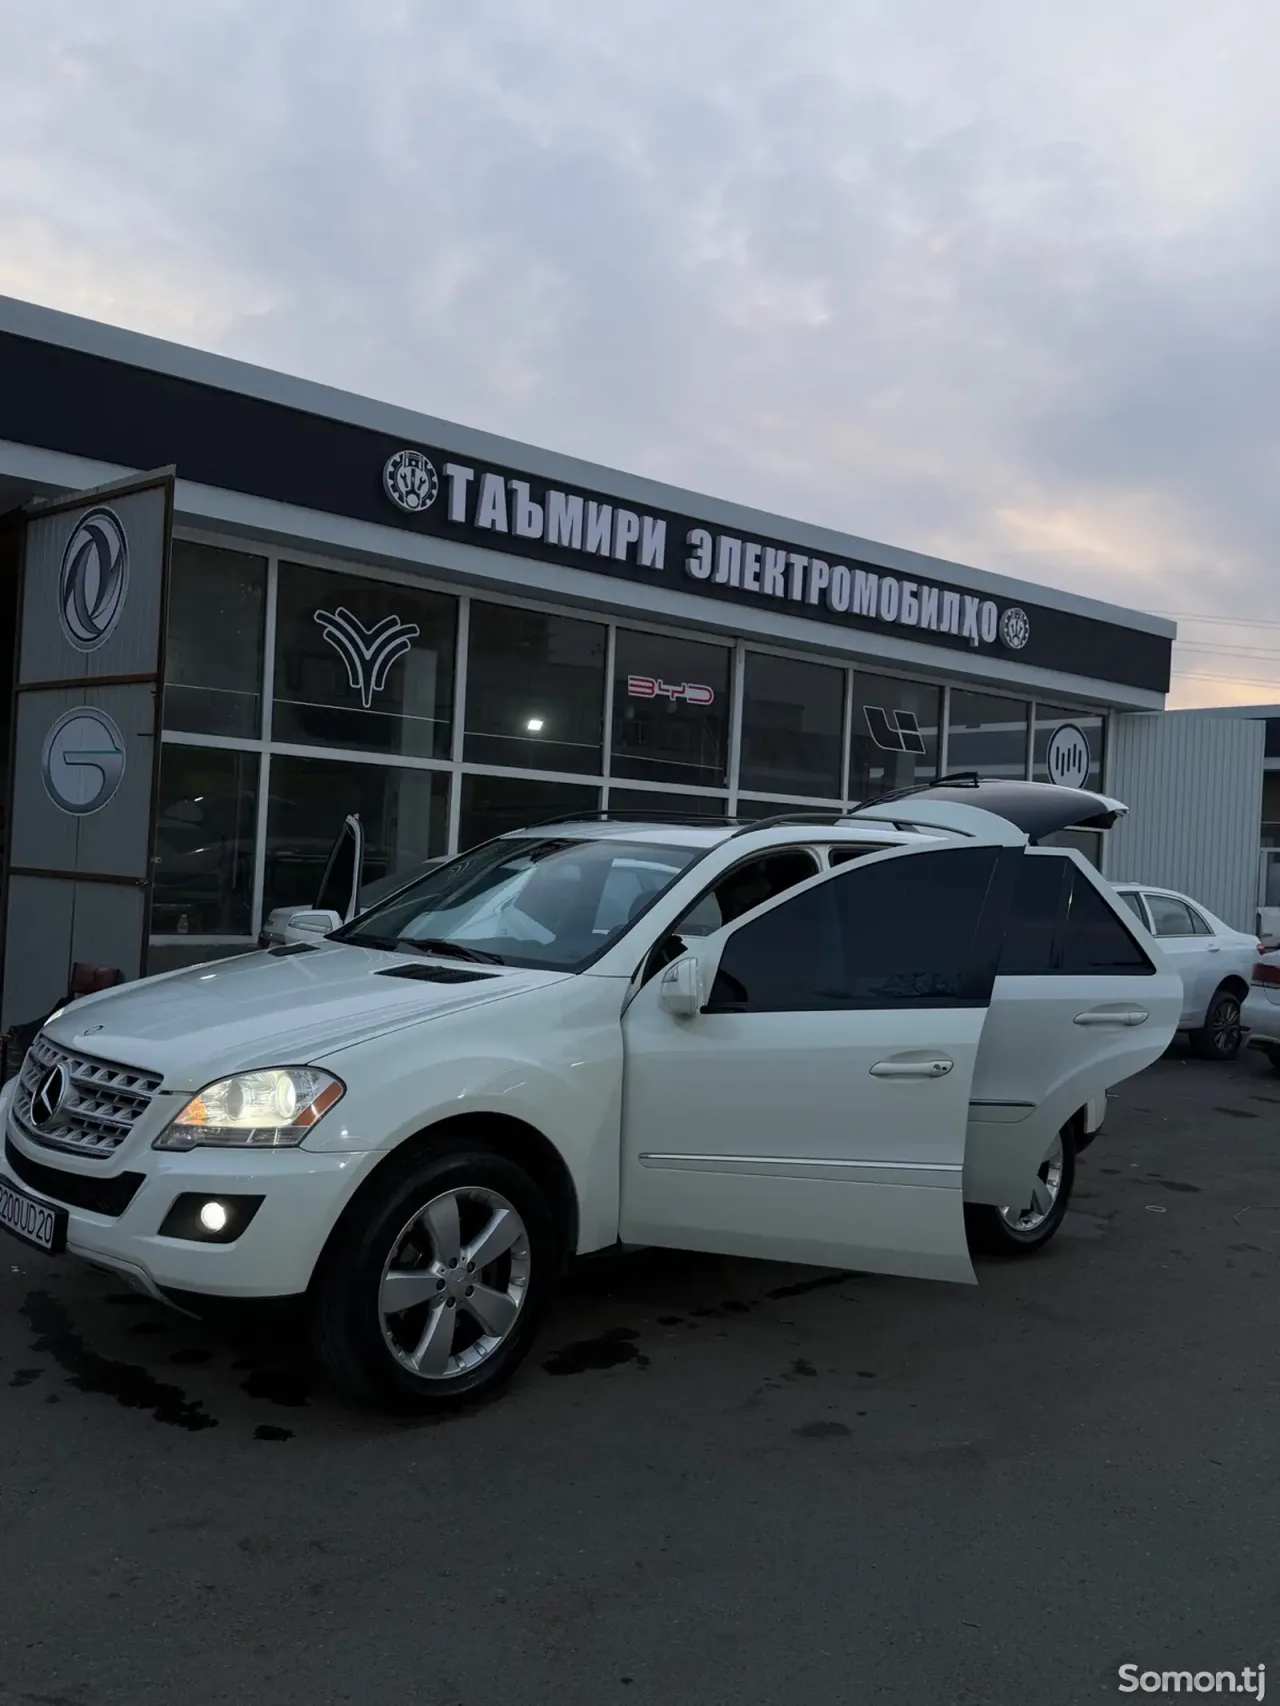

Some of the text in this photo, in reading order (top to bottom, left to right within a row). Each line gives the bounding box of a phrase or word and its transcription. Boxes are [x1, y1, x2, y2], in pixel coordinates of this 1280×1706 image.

[442, 462, 998, 647] ТАЪМИРИ ЭЛЕКТРОМОБИЛҲО
[627, 675, 714, 705] BYD
